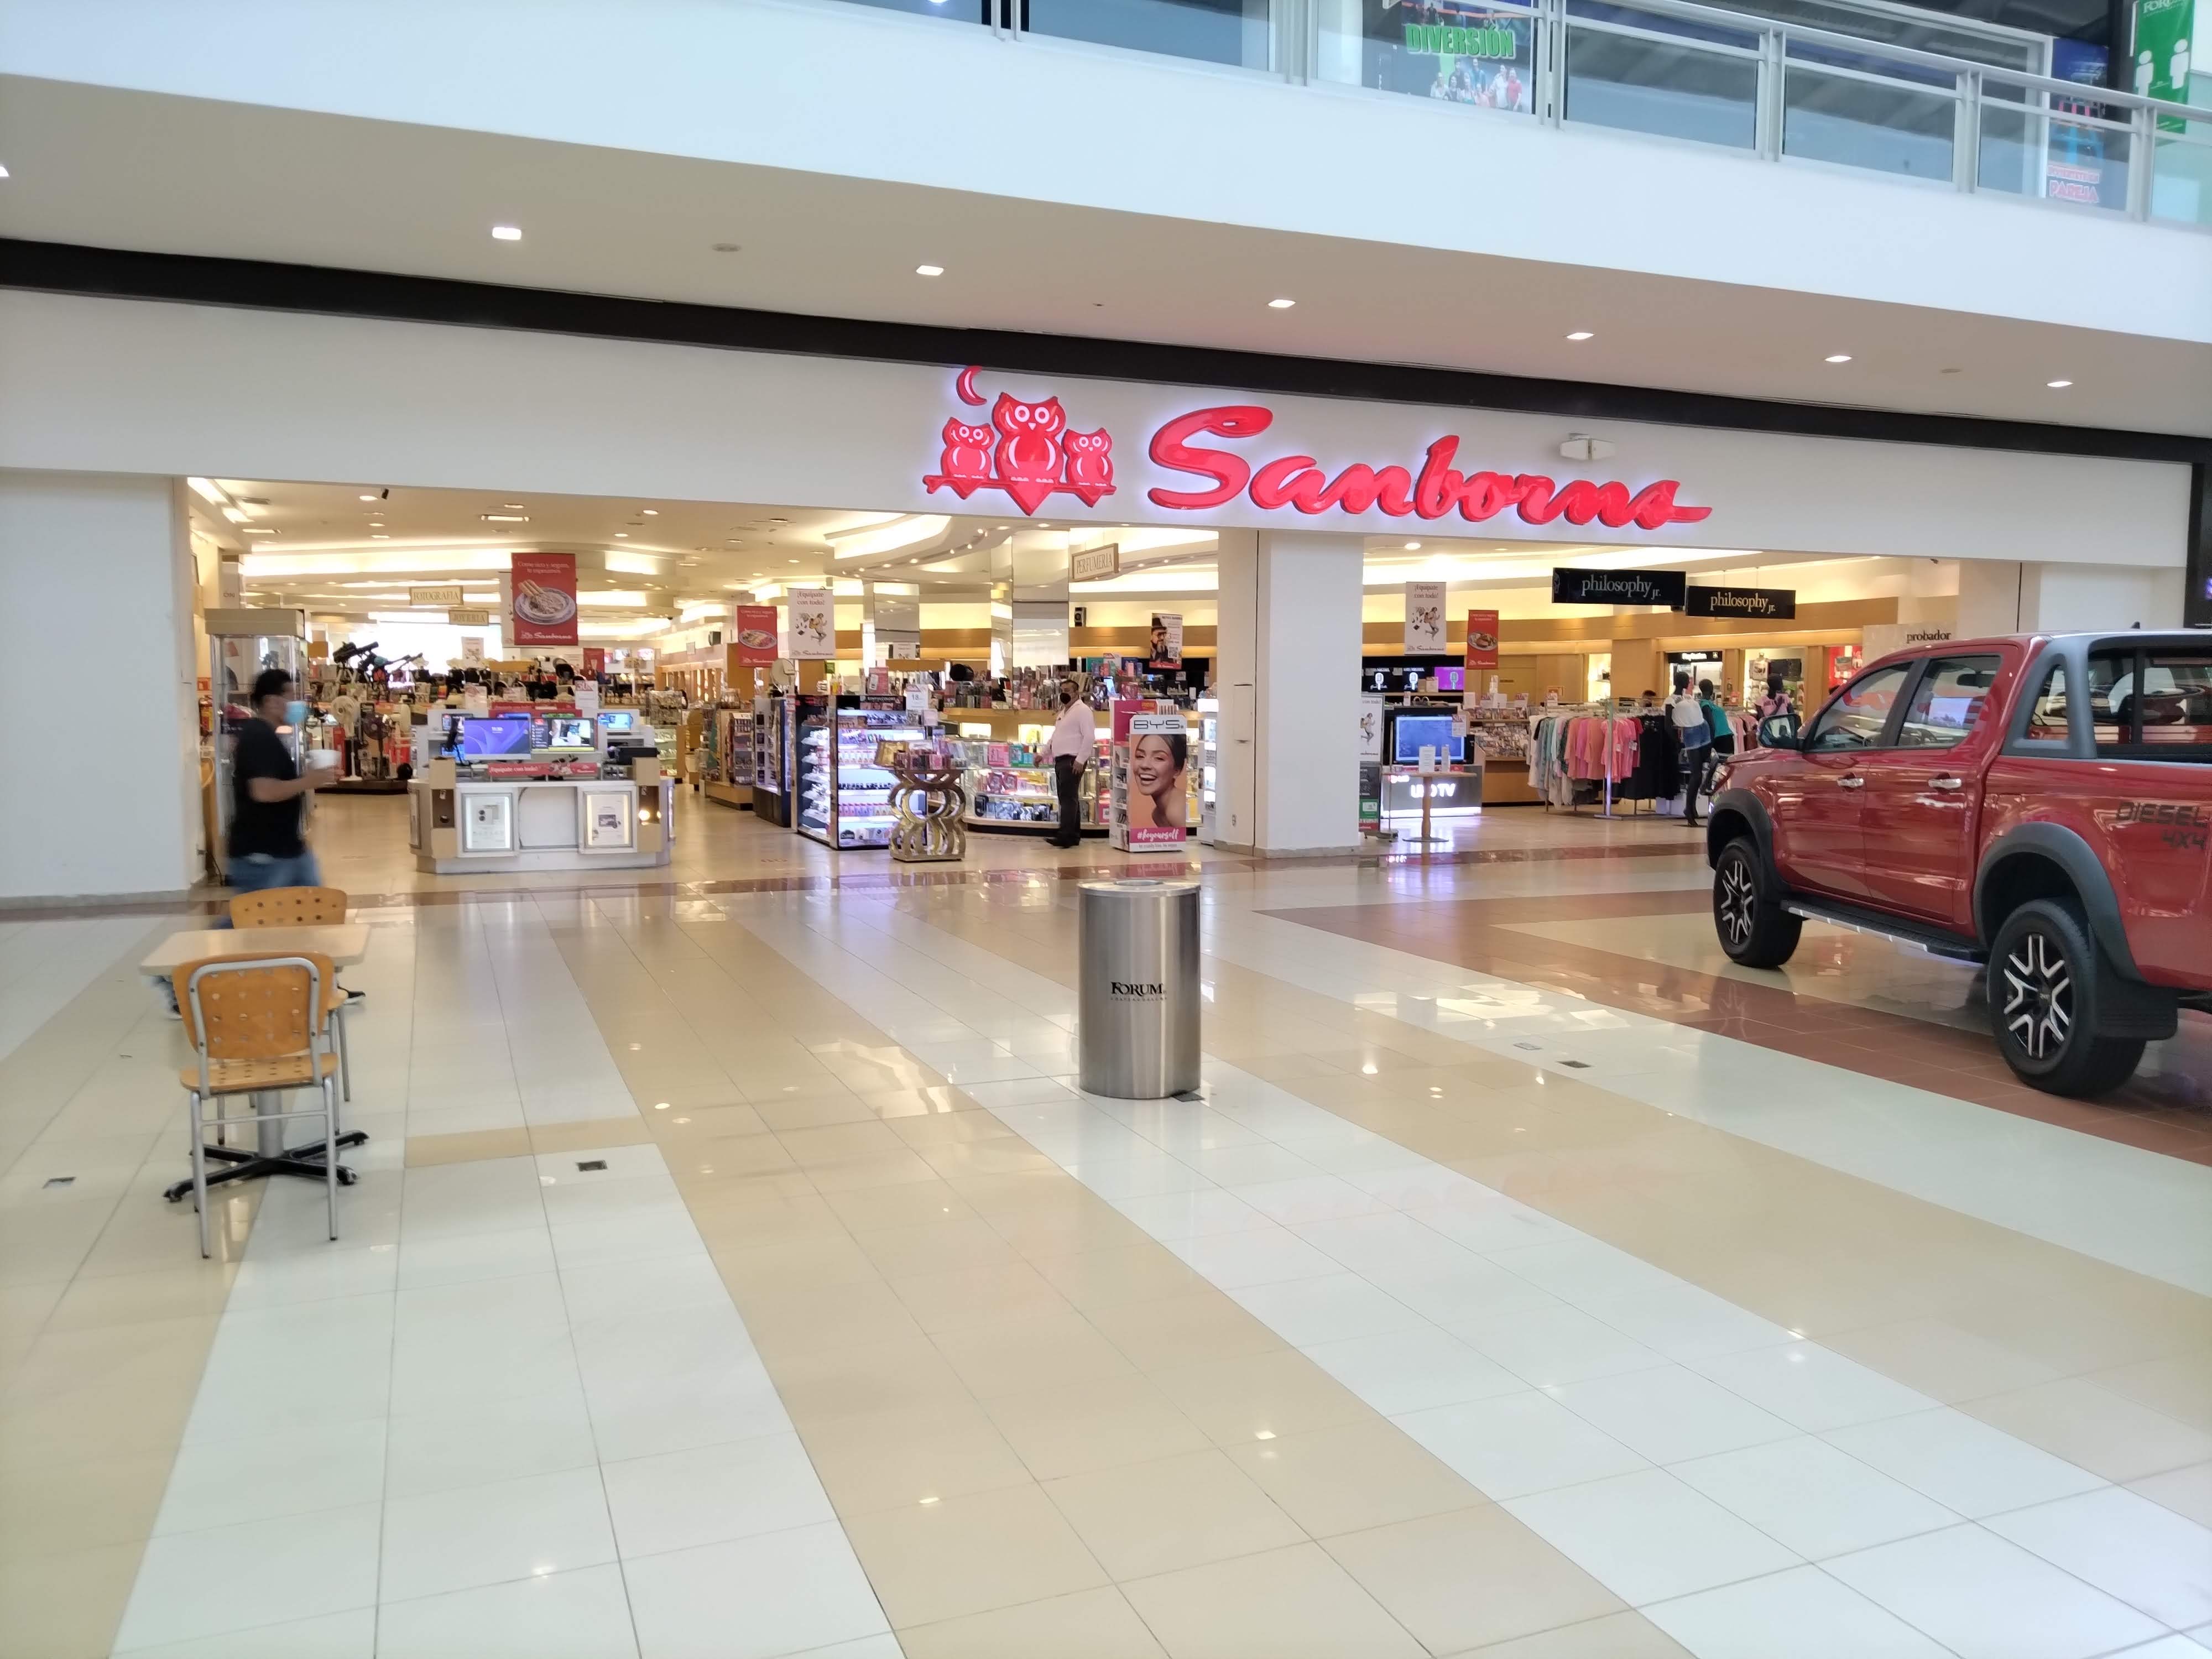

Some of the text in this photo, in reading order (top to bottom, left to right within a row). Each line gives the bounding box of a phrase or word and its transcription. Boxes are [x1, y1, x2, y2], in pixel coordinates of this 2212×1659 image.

[1406, 23, 1516, 58] DIVERSIÓN
[1147, 406, 1712, 530] Sanborns
[1582, 575, 1661, 600] philosophy jr.
[1710, 592, 1769, 613] philosophy
[1907, 629, 1952, 644] probador
[1437, 783, 1456, 797] TV
[2117, 802, 2208, 827] DIESEL
[1110, 981, 1164, 997] FORUM
